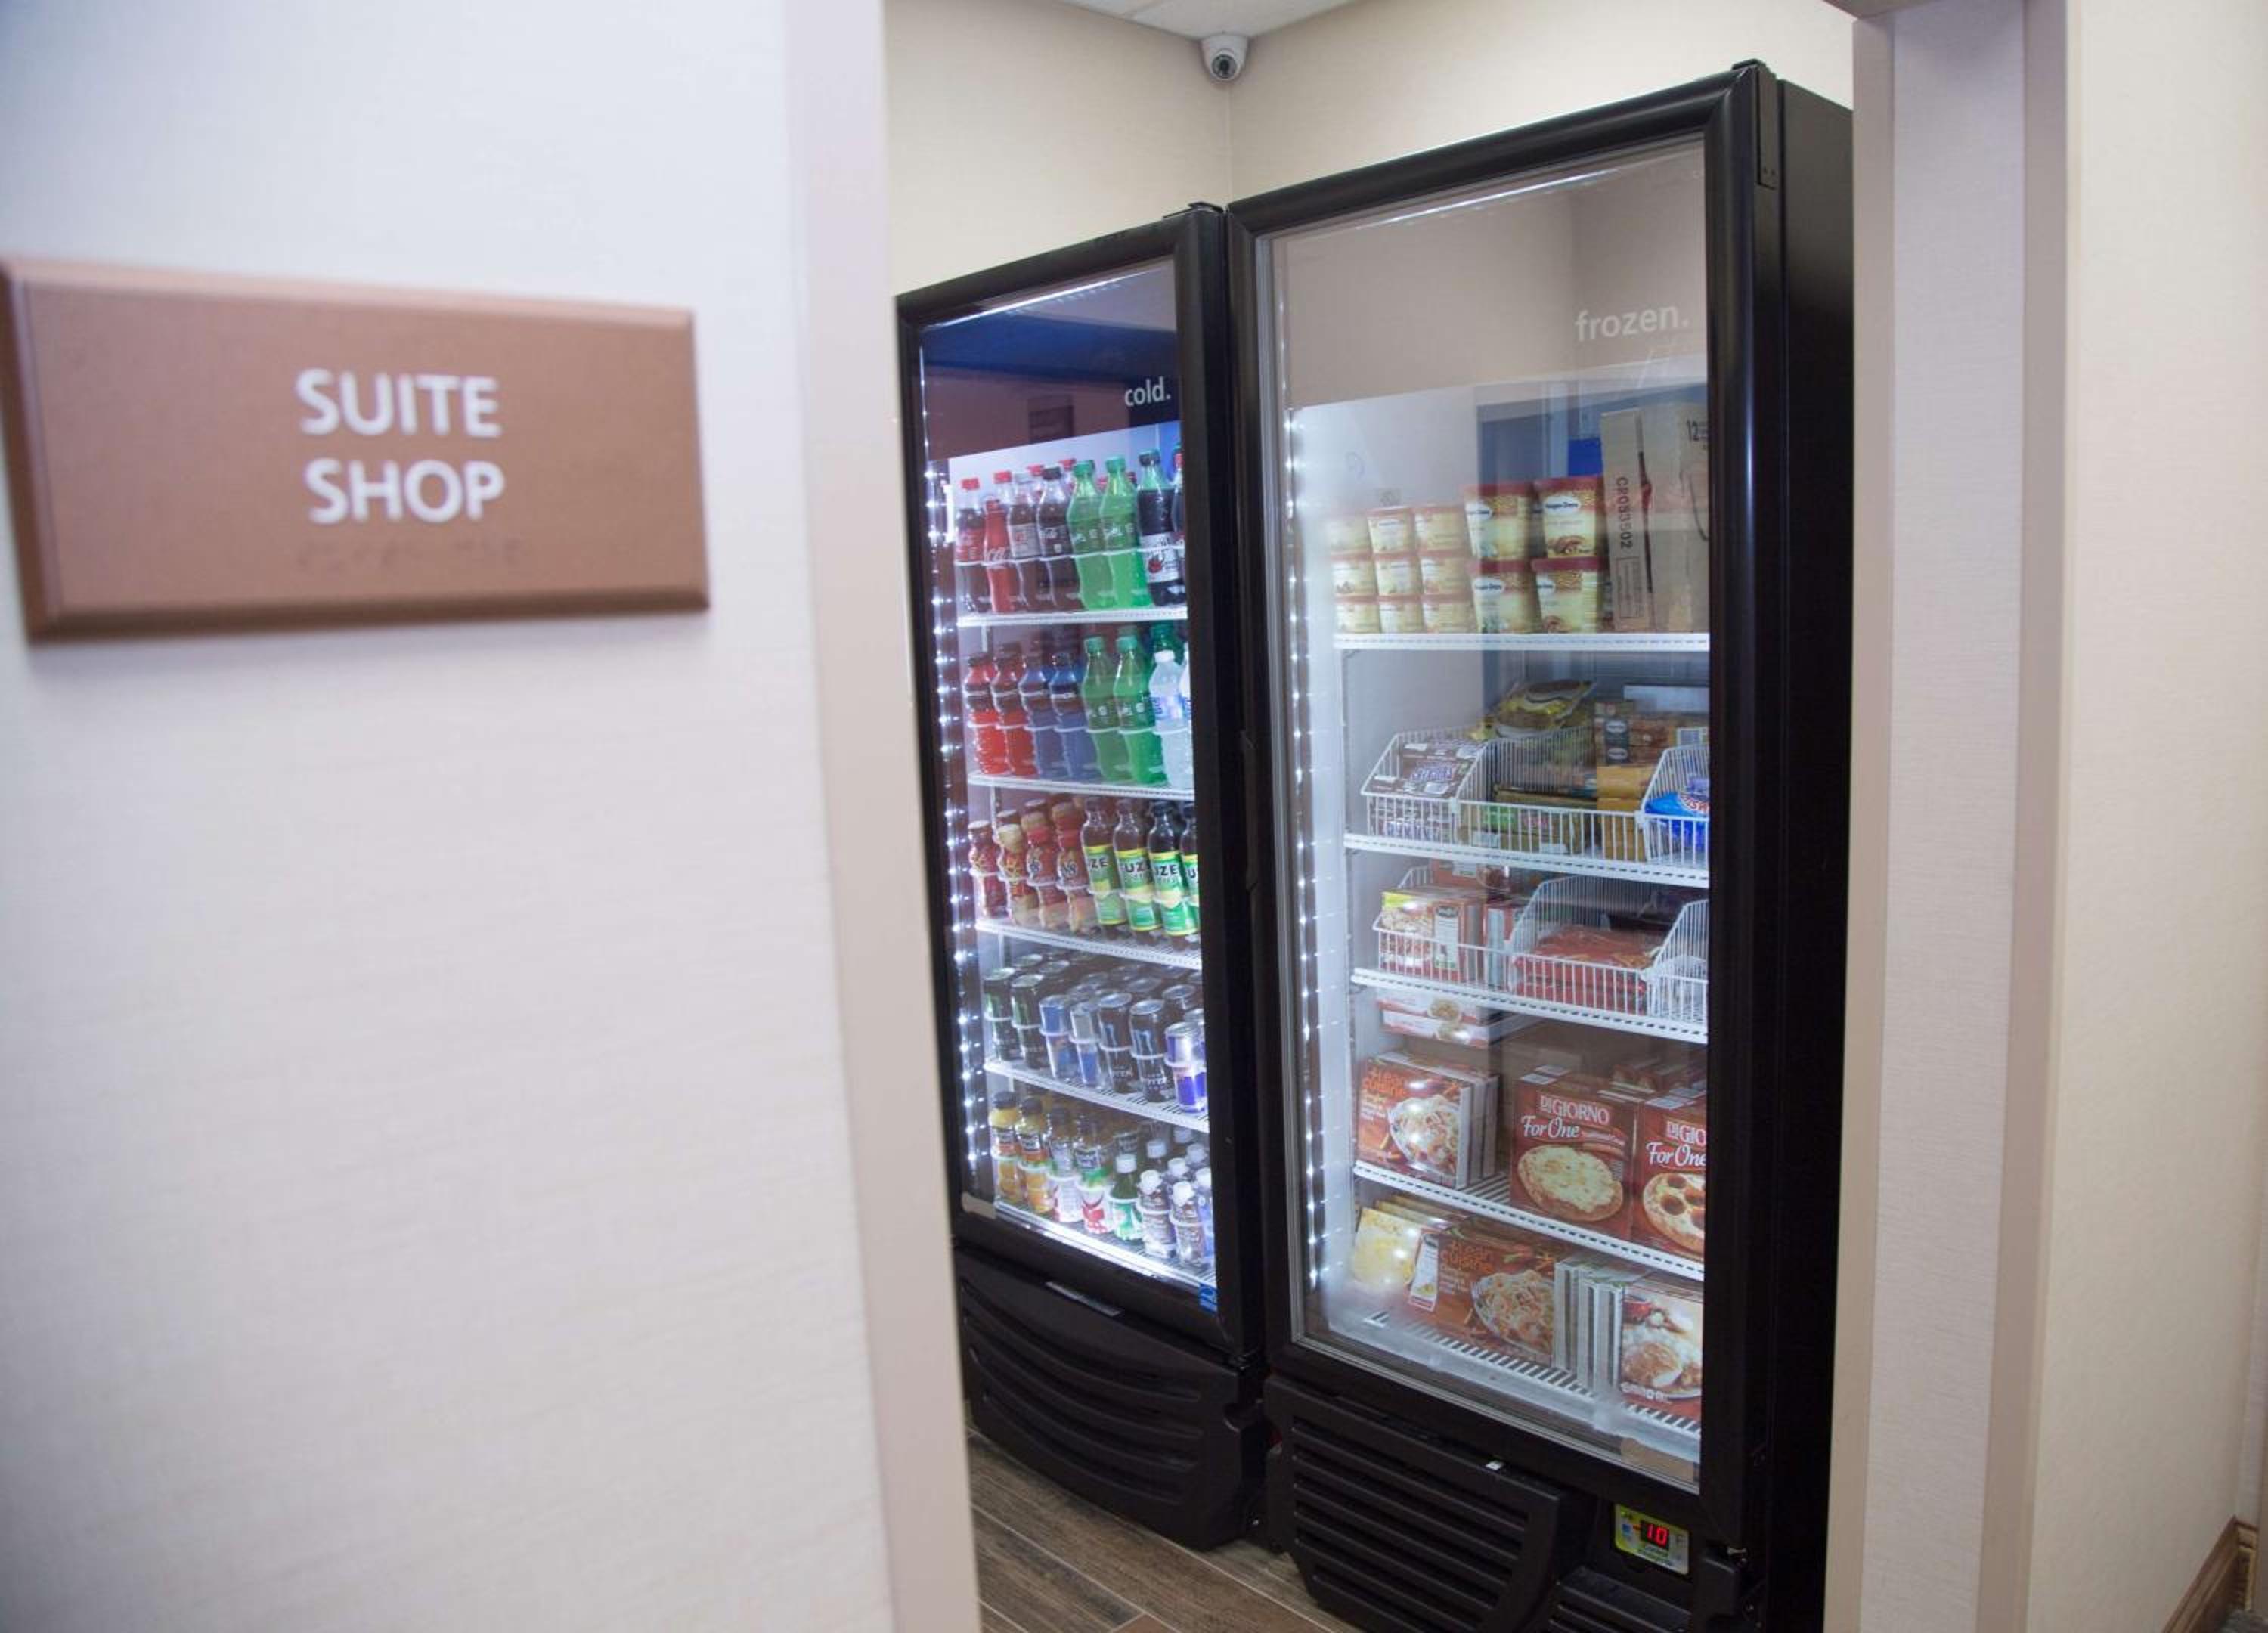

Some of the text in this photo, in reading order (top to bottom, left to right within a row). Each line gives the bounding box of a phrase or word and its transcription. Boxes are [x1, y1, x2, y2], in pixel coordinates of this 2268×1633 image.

[1575, 305, 1690, 342] frozen.
[296, 368, 503, 438] SUITE
[1125, 376, 1171, 407] cold.
[305, 457, 505, 524] SHOP
[1540, 1095, 1610, 1125] DIGIORNO
[1521, 1115, 1547, 1138] For
[1548, 1117, 1580, 1139] One
[1666, 1120, 1706, 1147] DIGIO
[1645, 1142, 1675, 1166] For
